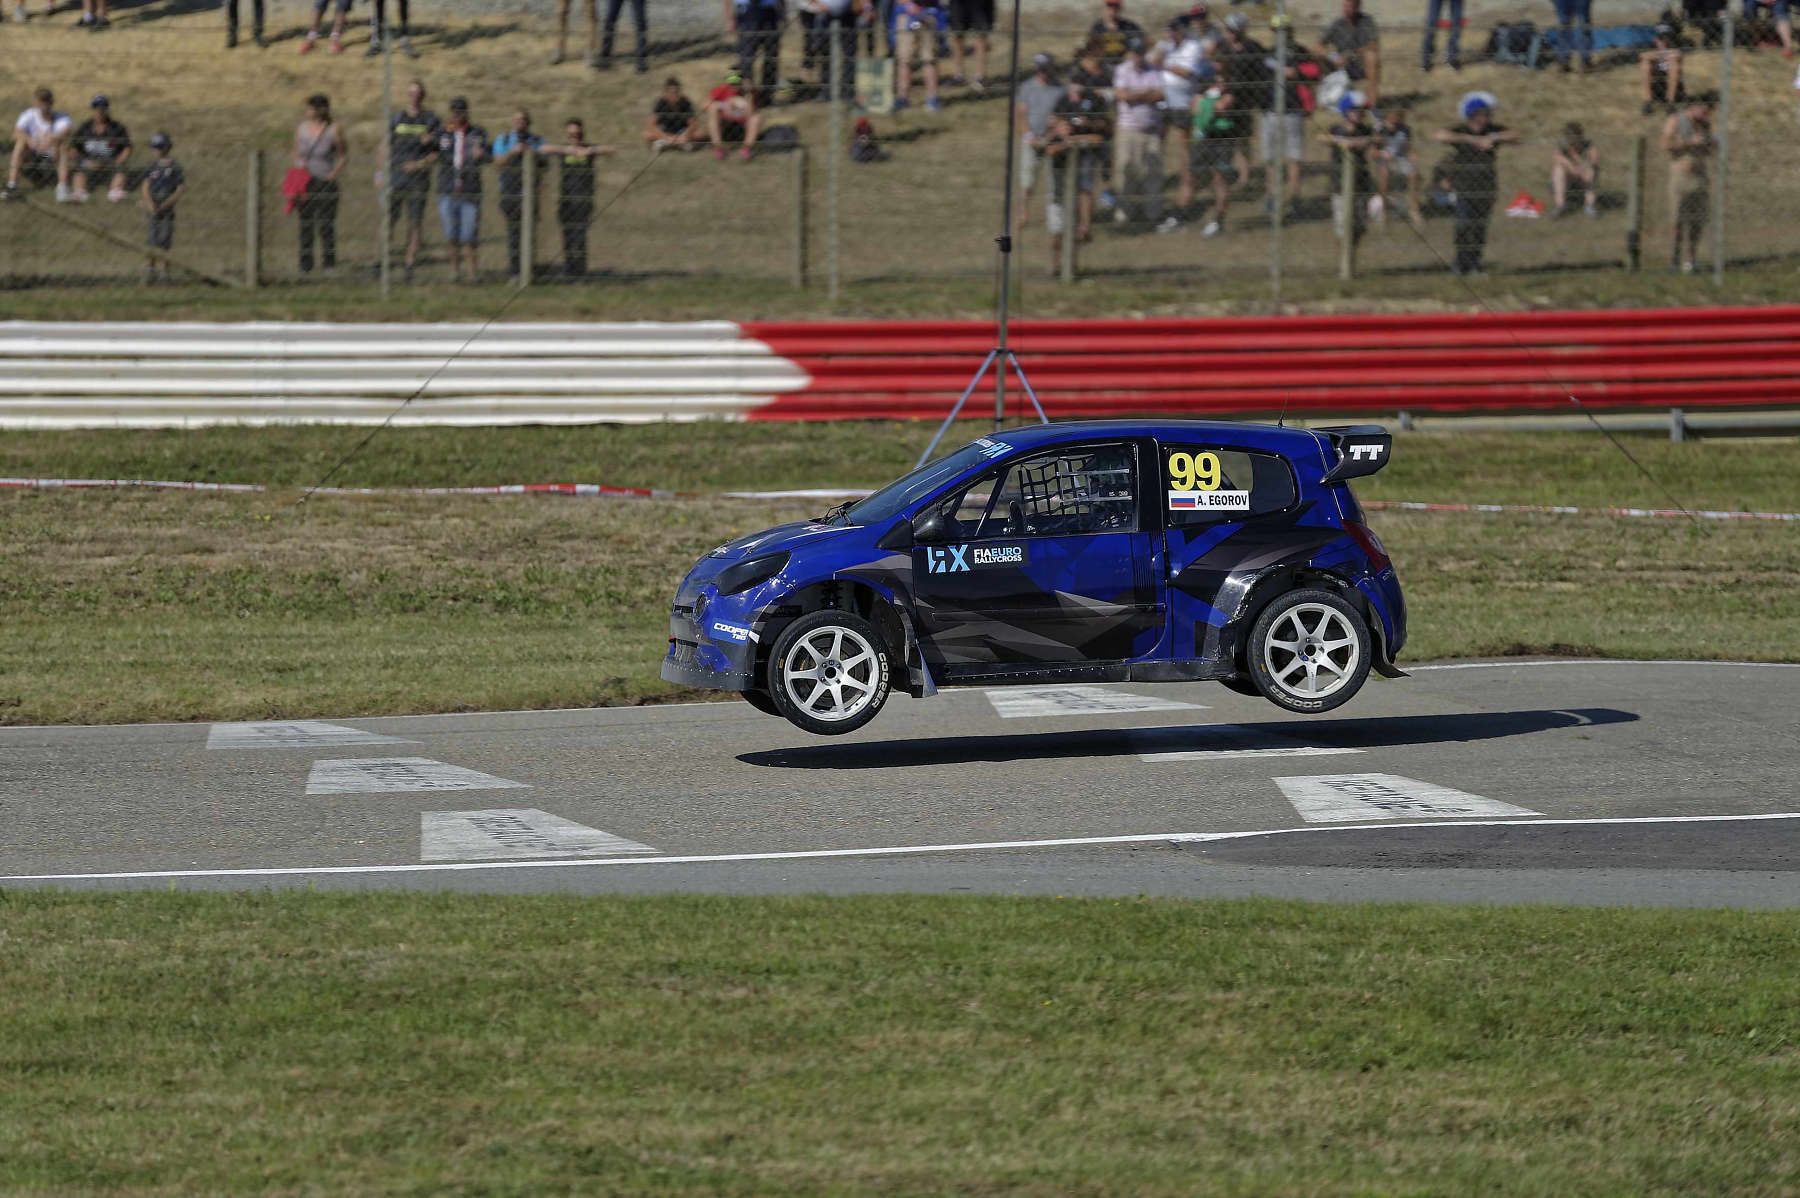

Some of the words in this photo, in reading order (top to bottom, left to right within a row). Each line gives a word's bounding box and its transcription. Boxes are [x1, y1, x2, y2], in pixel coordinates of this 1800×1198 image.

[1349, 445, 1384, 460] TT
[1168, 452, 1221, 491] 99
[1197, 495, 1207, 506] A.
[1209, 495, 1247, 506] EGOROV
[974, 554, 1022, 564] RALLYCROSS
[871, 652, 889, 709] COOPER
[1270, 685, 1323, 708] COOPER
